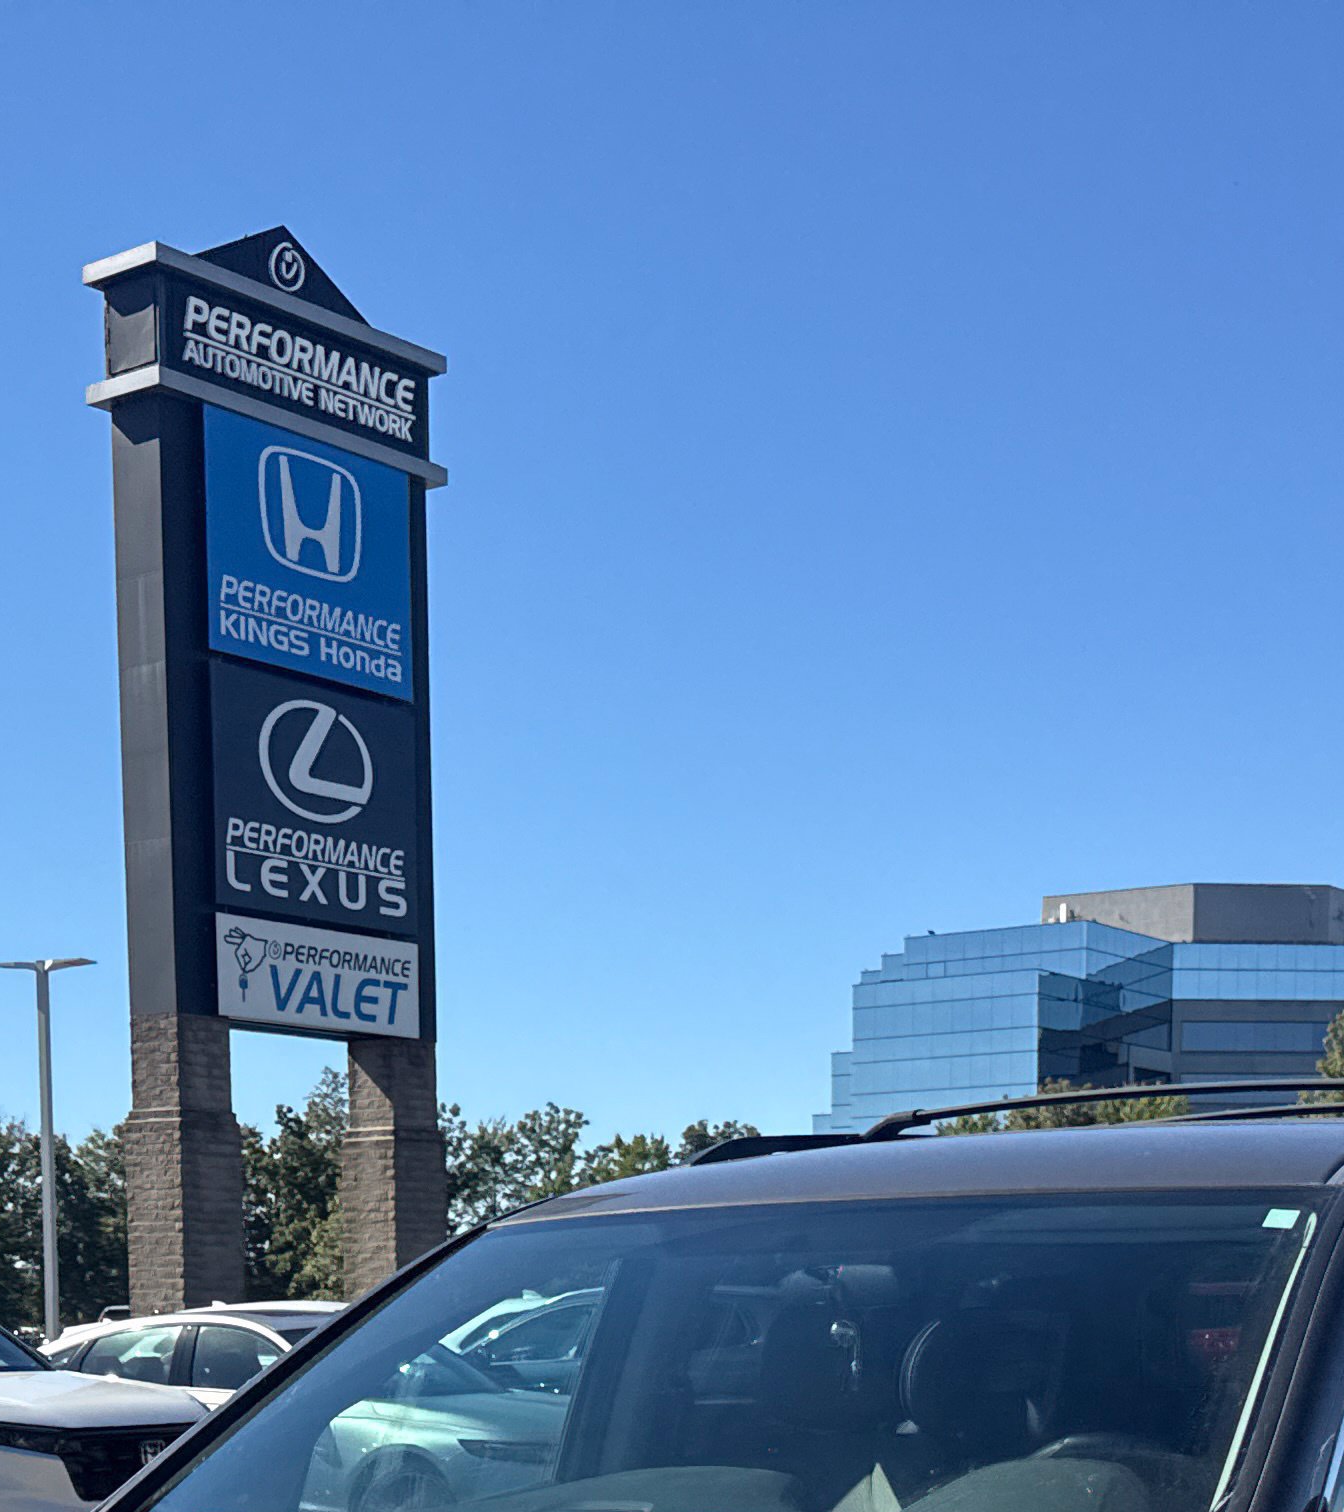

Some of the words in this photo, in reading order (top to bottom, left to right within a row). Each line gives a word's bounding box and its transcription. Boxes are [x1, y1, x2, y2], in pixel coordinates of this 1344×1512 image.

[184, 296, 416, 412] PERFORMANCE
[183, 340, 314, 407] AUTOMOTIVE
[319, 387, 413, 442] NETWORK
[221, 575, 400, 650] PERFORMANCE
[221, 610, 309, 656] KINGS
[320, 638, 402, 682] Honda
[226, 817, 405, 876] PERFORMANCE
[226, 850, 406, 917] LEXUS
[270, 964, 408, 1025] VALET
[283, 942, 410, 979] PERFORMANCE
